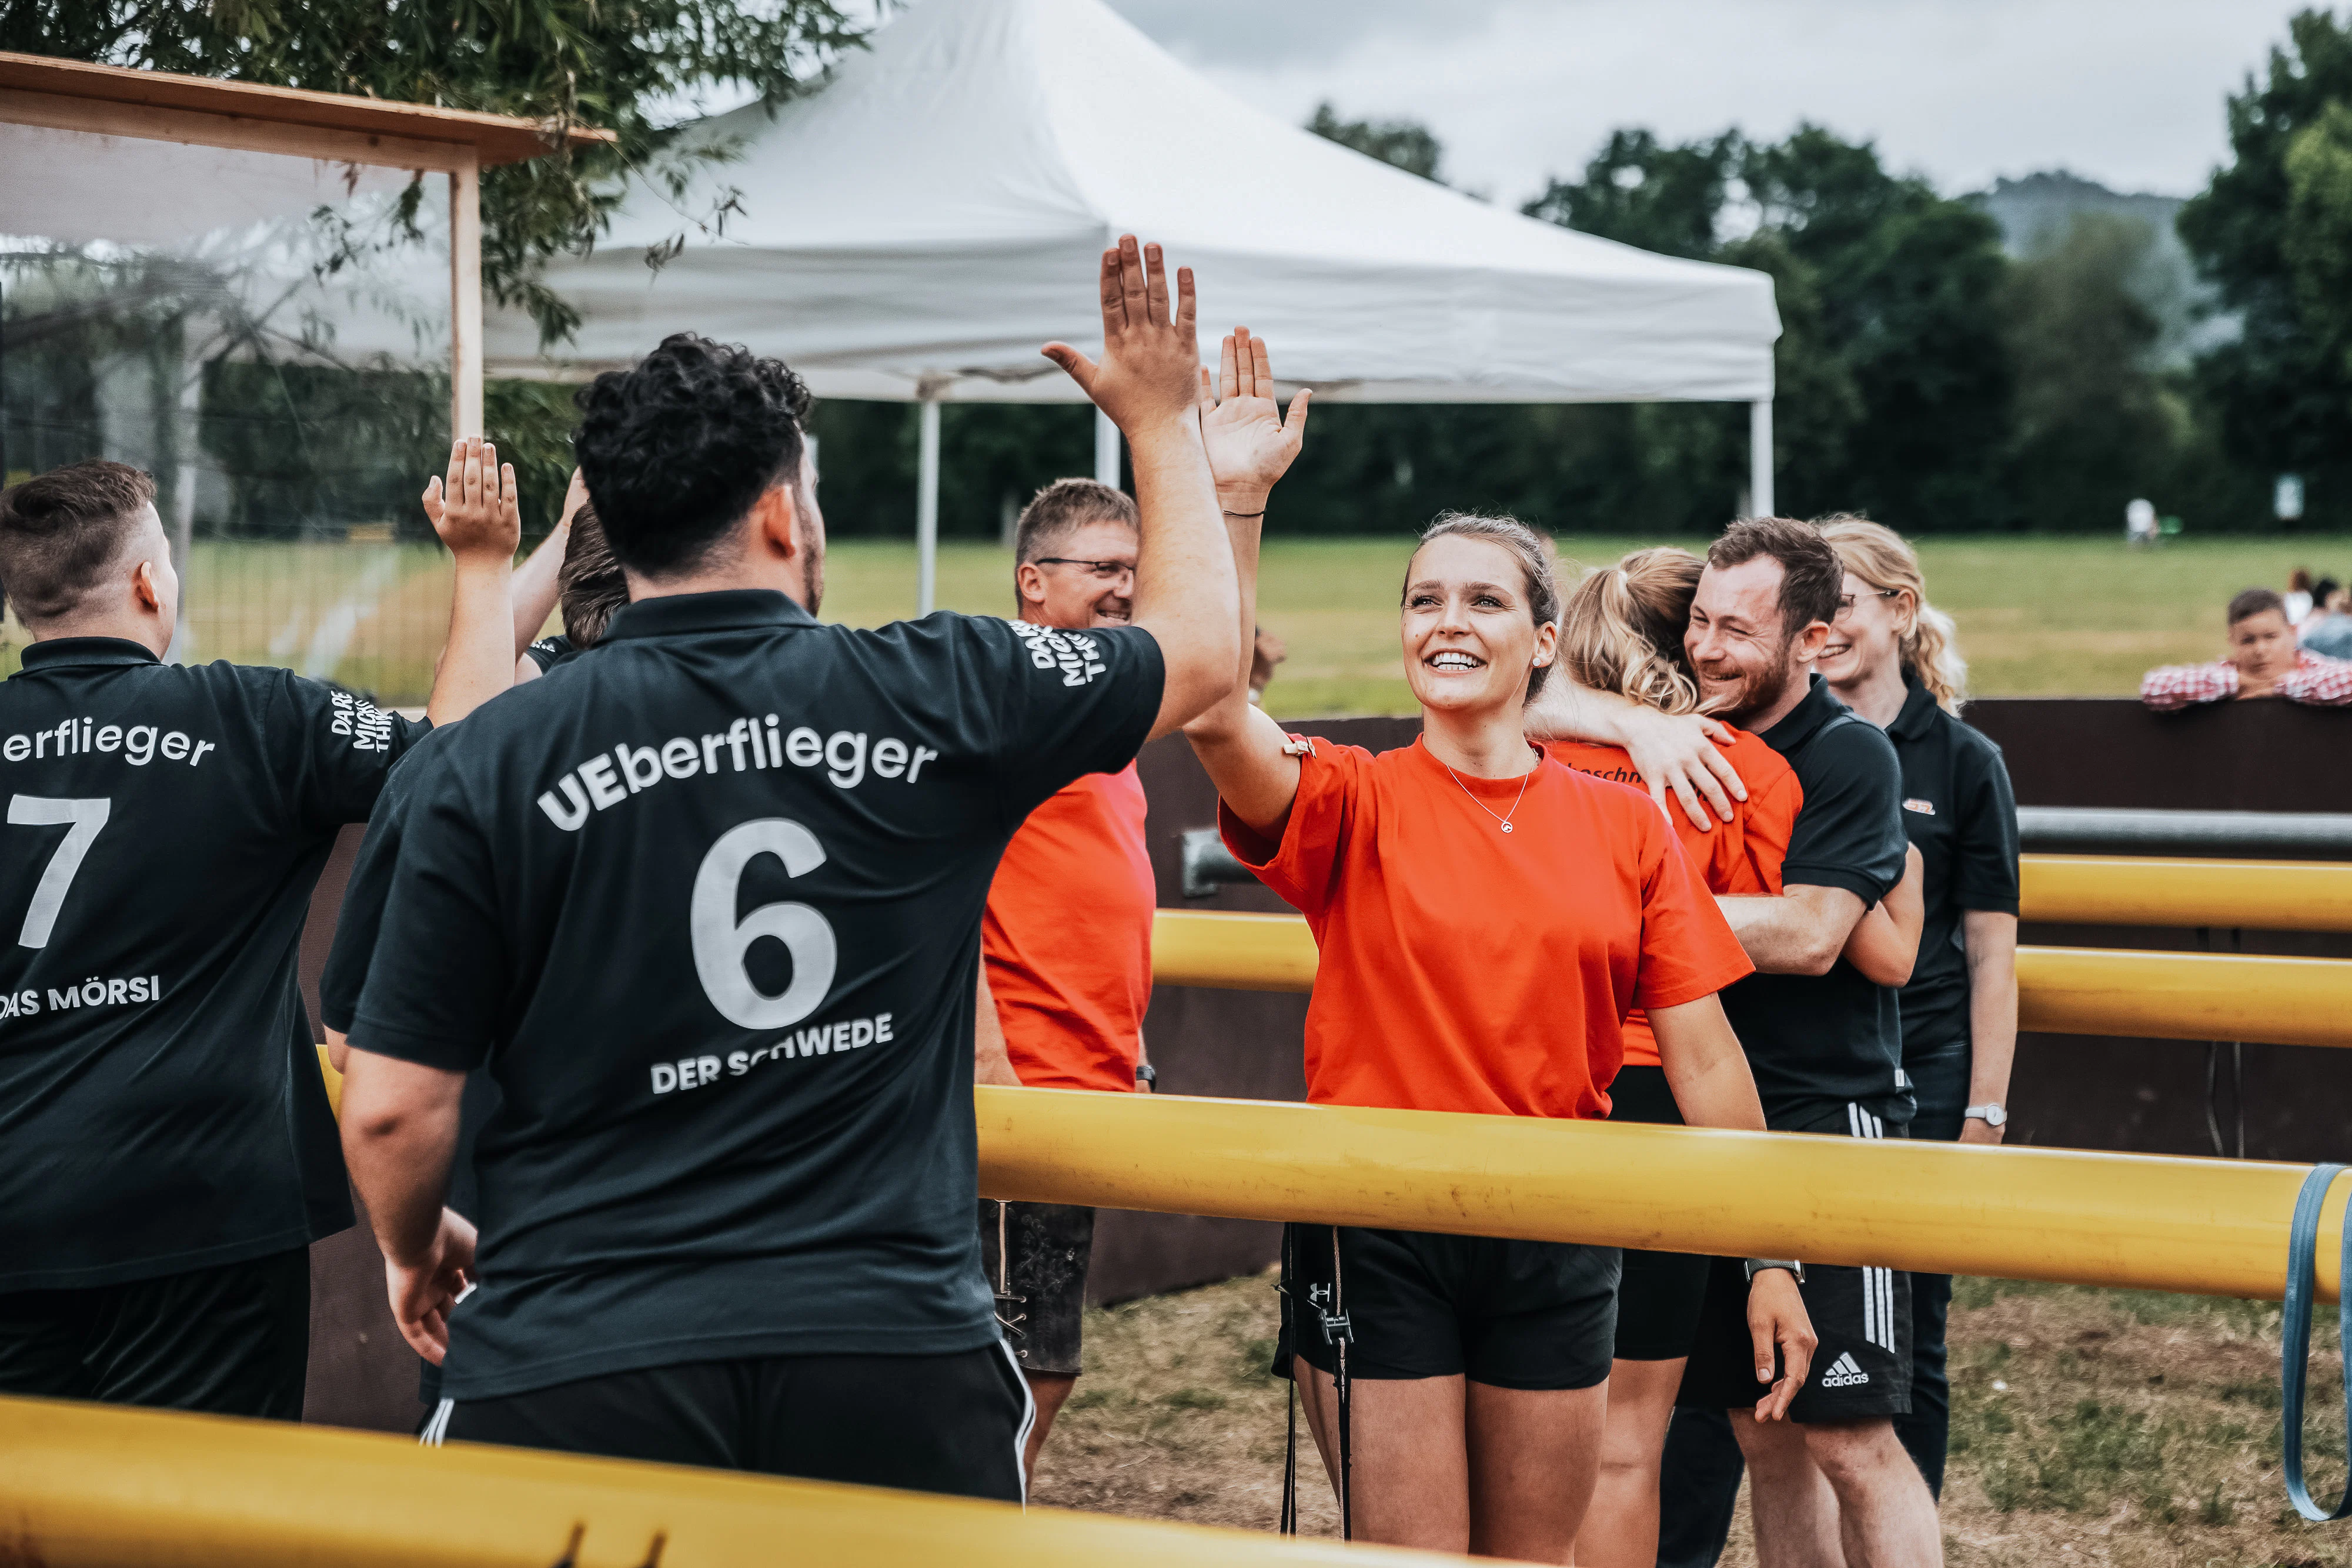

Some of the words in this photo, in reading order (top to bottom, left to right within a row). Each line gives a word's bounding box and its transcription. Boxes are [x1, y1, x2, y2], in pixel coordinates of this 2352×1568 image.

[330, 690, 355, 735] DARE
[3, 716, 215, 767] erflieger
[537, 713, 938, 831] UEberflieger
[7, 794, 111, 949] 7
[690, 817, 837, 1030] 6
[48, 975, 159, 1011] MÖRSI
[650, 1055, 723, 1094] DER
[1823, 1373, 1869, 1387] adidas
